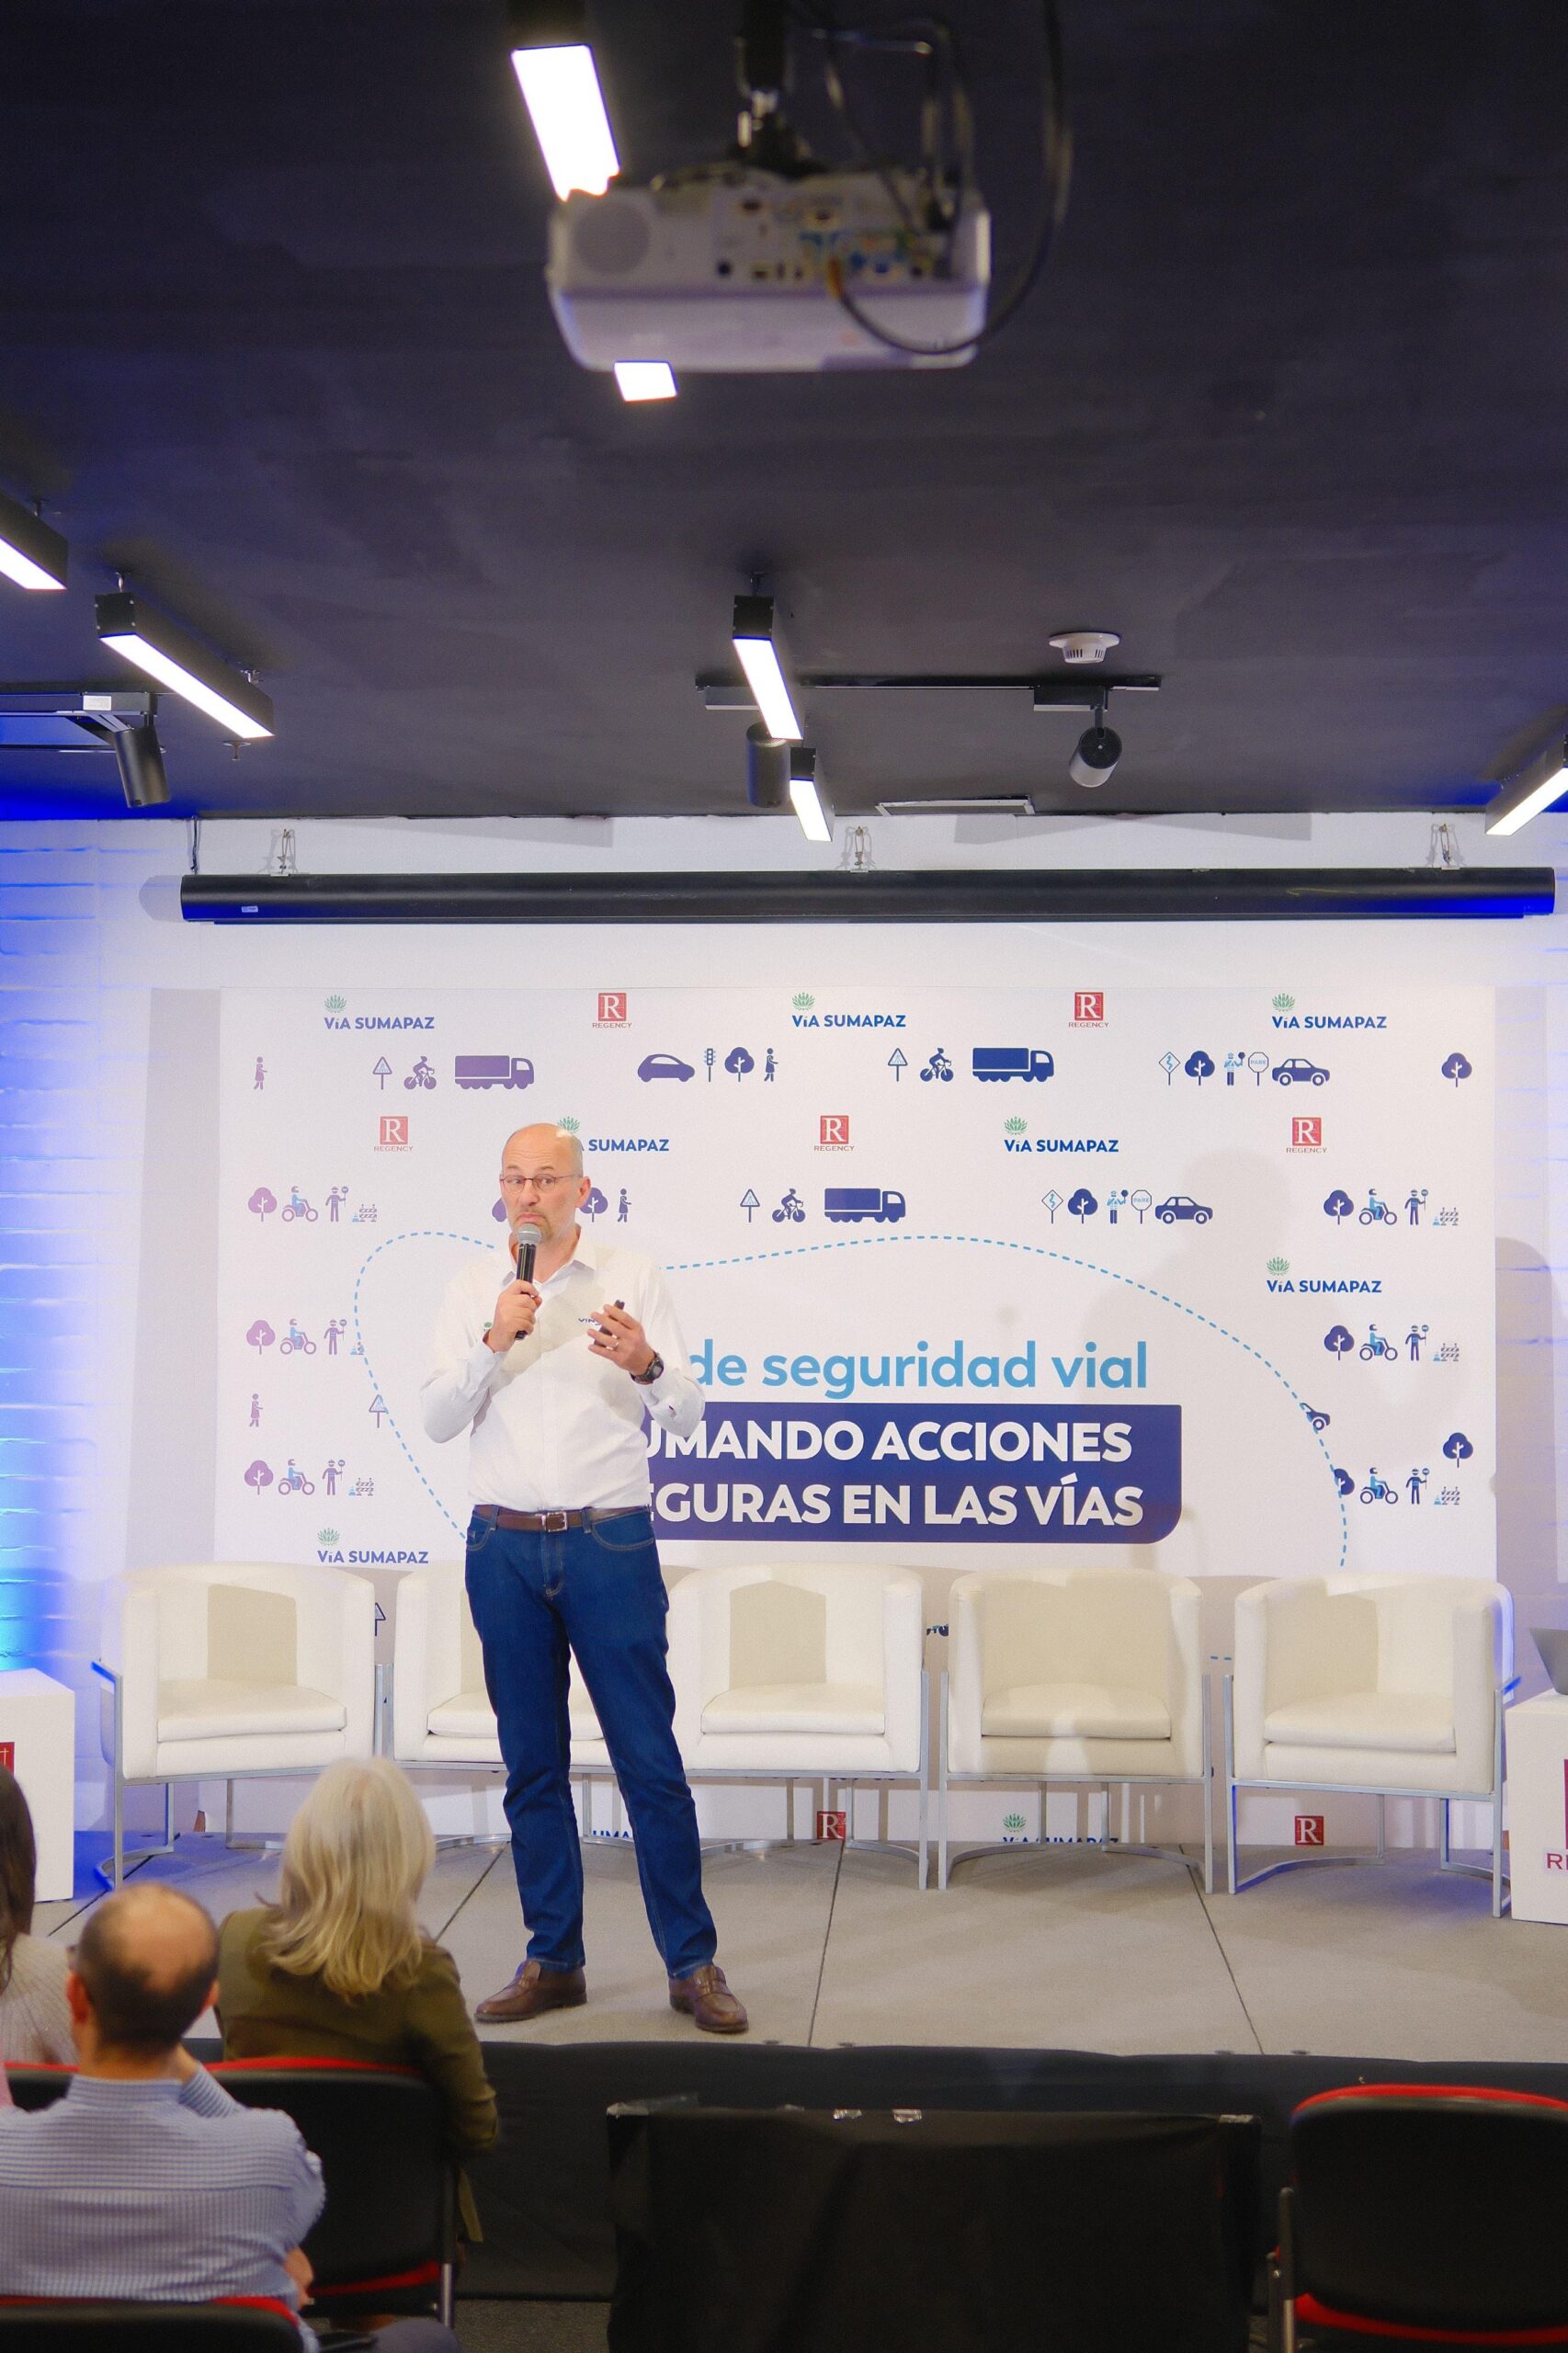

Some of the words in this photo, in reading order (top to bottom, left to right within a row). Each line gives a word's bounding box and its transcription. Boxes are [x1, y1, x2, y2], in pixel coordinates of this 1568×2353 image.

[599, 995, 625, 1019] R
[1076, 994, 1102, 1018] R
[355, 1017, 435, 1029] SUMAPAZ
[824, 1015, 906, 1028] SUMAPAZ
[1304, 1016, 1387, 1029] SUMAPAZ
[381, 1118, 405, 1142] R
[823, 1118, 846, 1142] R
[1293, 1120, 1320, 1144] R
[588, 1139, 669, 1152] SUMAPAZ
[1036, 1139, 1119, 1153] SUMAPAZ
[1299, 1279, 1381, 1293] SUMAPAZ
[689, 1338, 747, 1386] de
[762, 1339, 1036, 1400] seguridad
[1051, 1341, 1147, 1389] vial
[646, 1420, 865, 1461] MANDO
[871, 1421, 1132, 1462] ACCIONES
[650, 1482, 831, 1524] GURAS
[843, 1484, 911, 1525] EN
[925, 1485, 1017, 1526] LAS
[1026, 1472, 1143, 1526] VÍAS
[348, 1550, 428, 1563] SUMAPAZ
[818, 1813, 845, 1839] R
[1296, 1817, 1323, 1844] R
